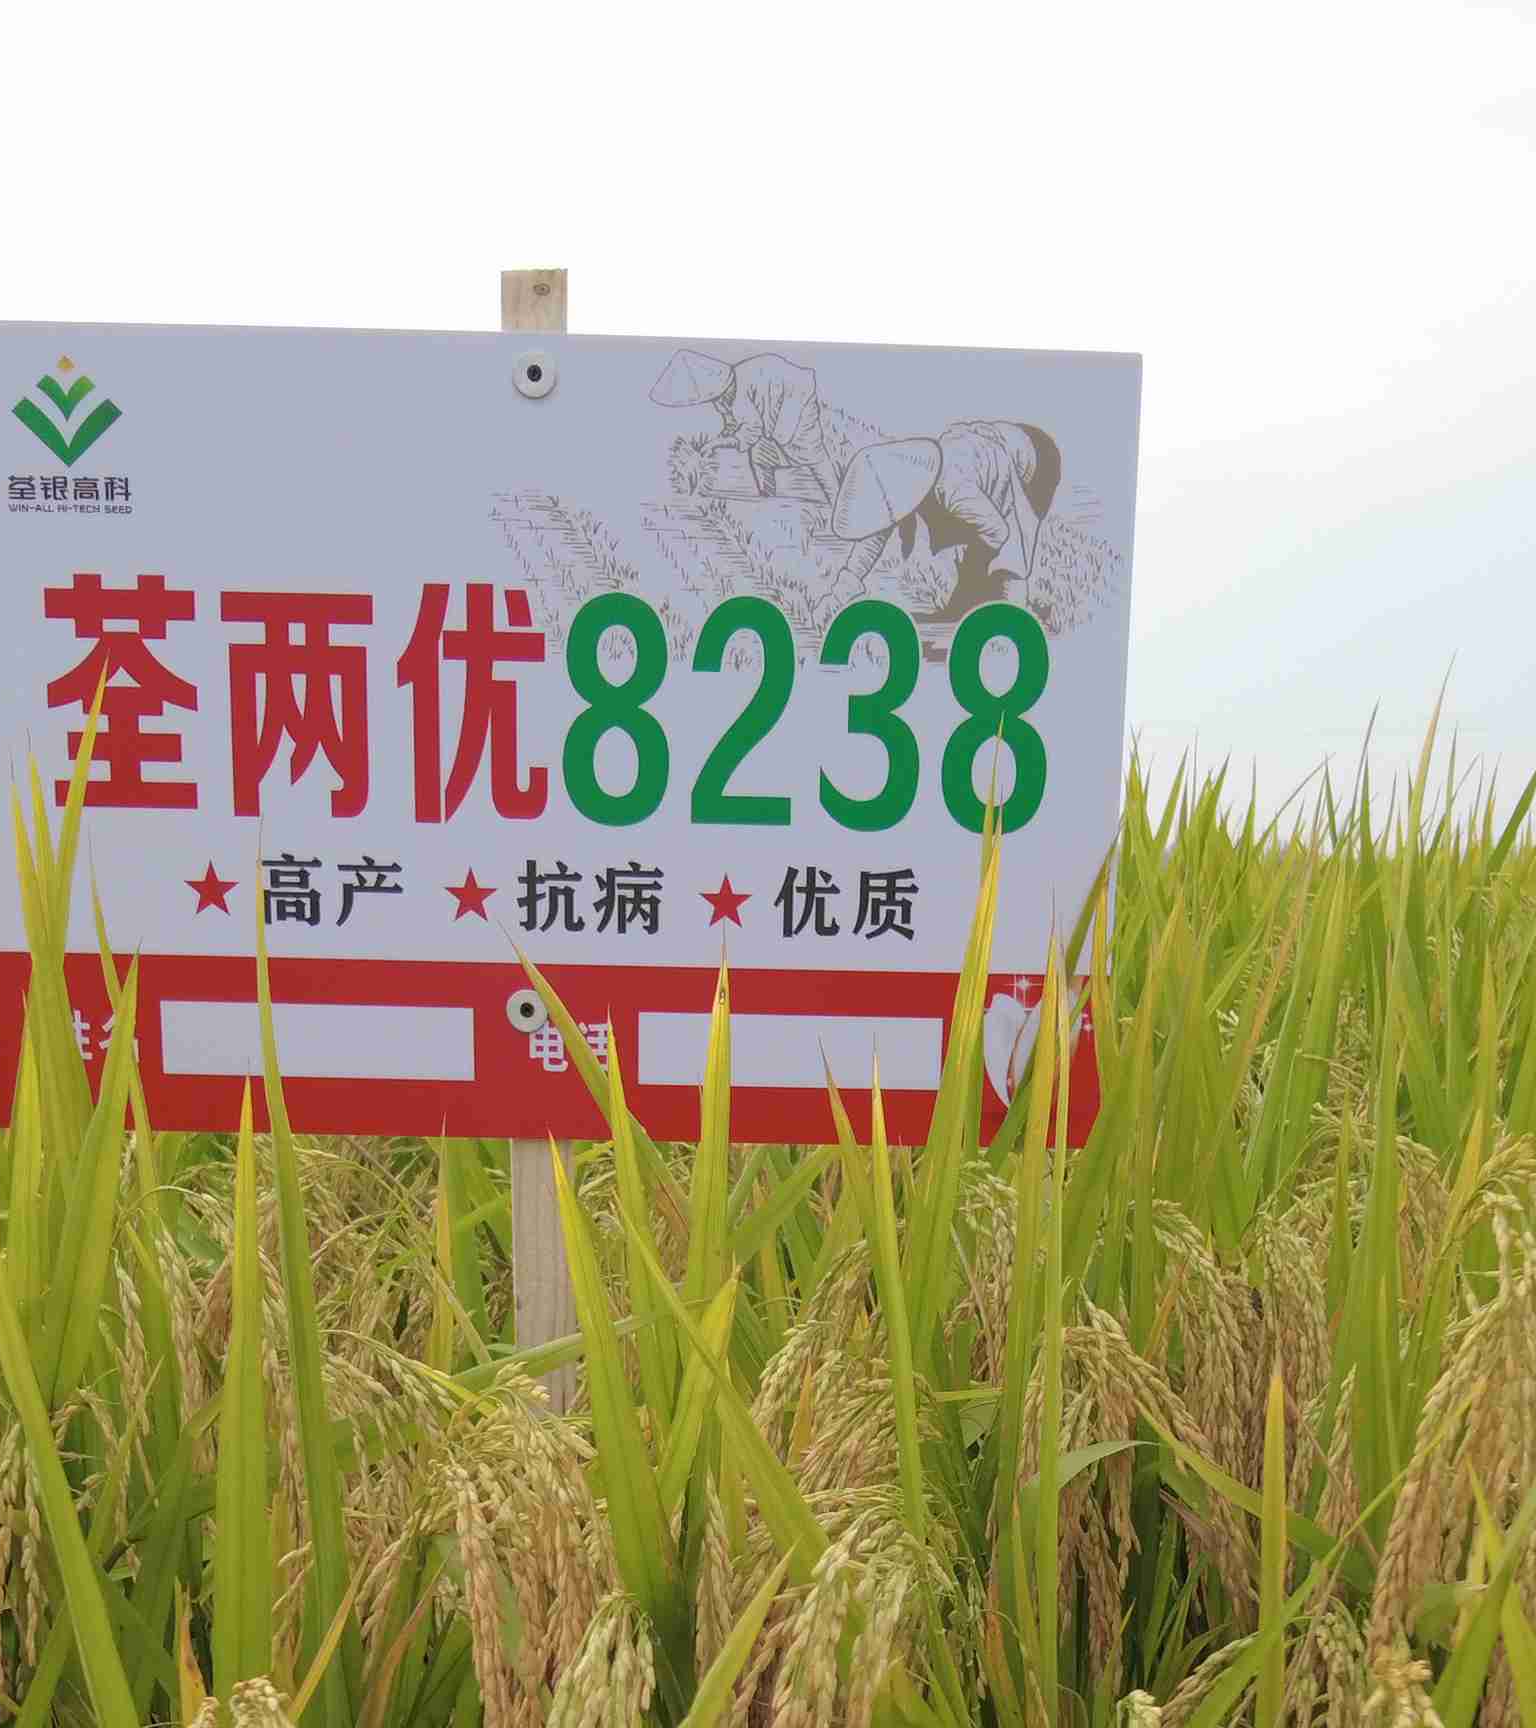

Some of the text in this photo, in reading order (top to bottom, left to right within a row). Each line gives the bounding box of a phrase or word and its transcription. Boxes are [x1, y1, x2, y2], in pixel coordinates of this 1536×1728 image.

[7, 474, 132, 502] 荃银高科
[8, 503, 55, 513] WIN-ALL
[103, 504, 133, 515] SEED
[44, 575, 1048, 832] 荃两优8238
[261, 853, 919, 941] 高产 抗病 优质
